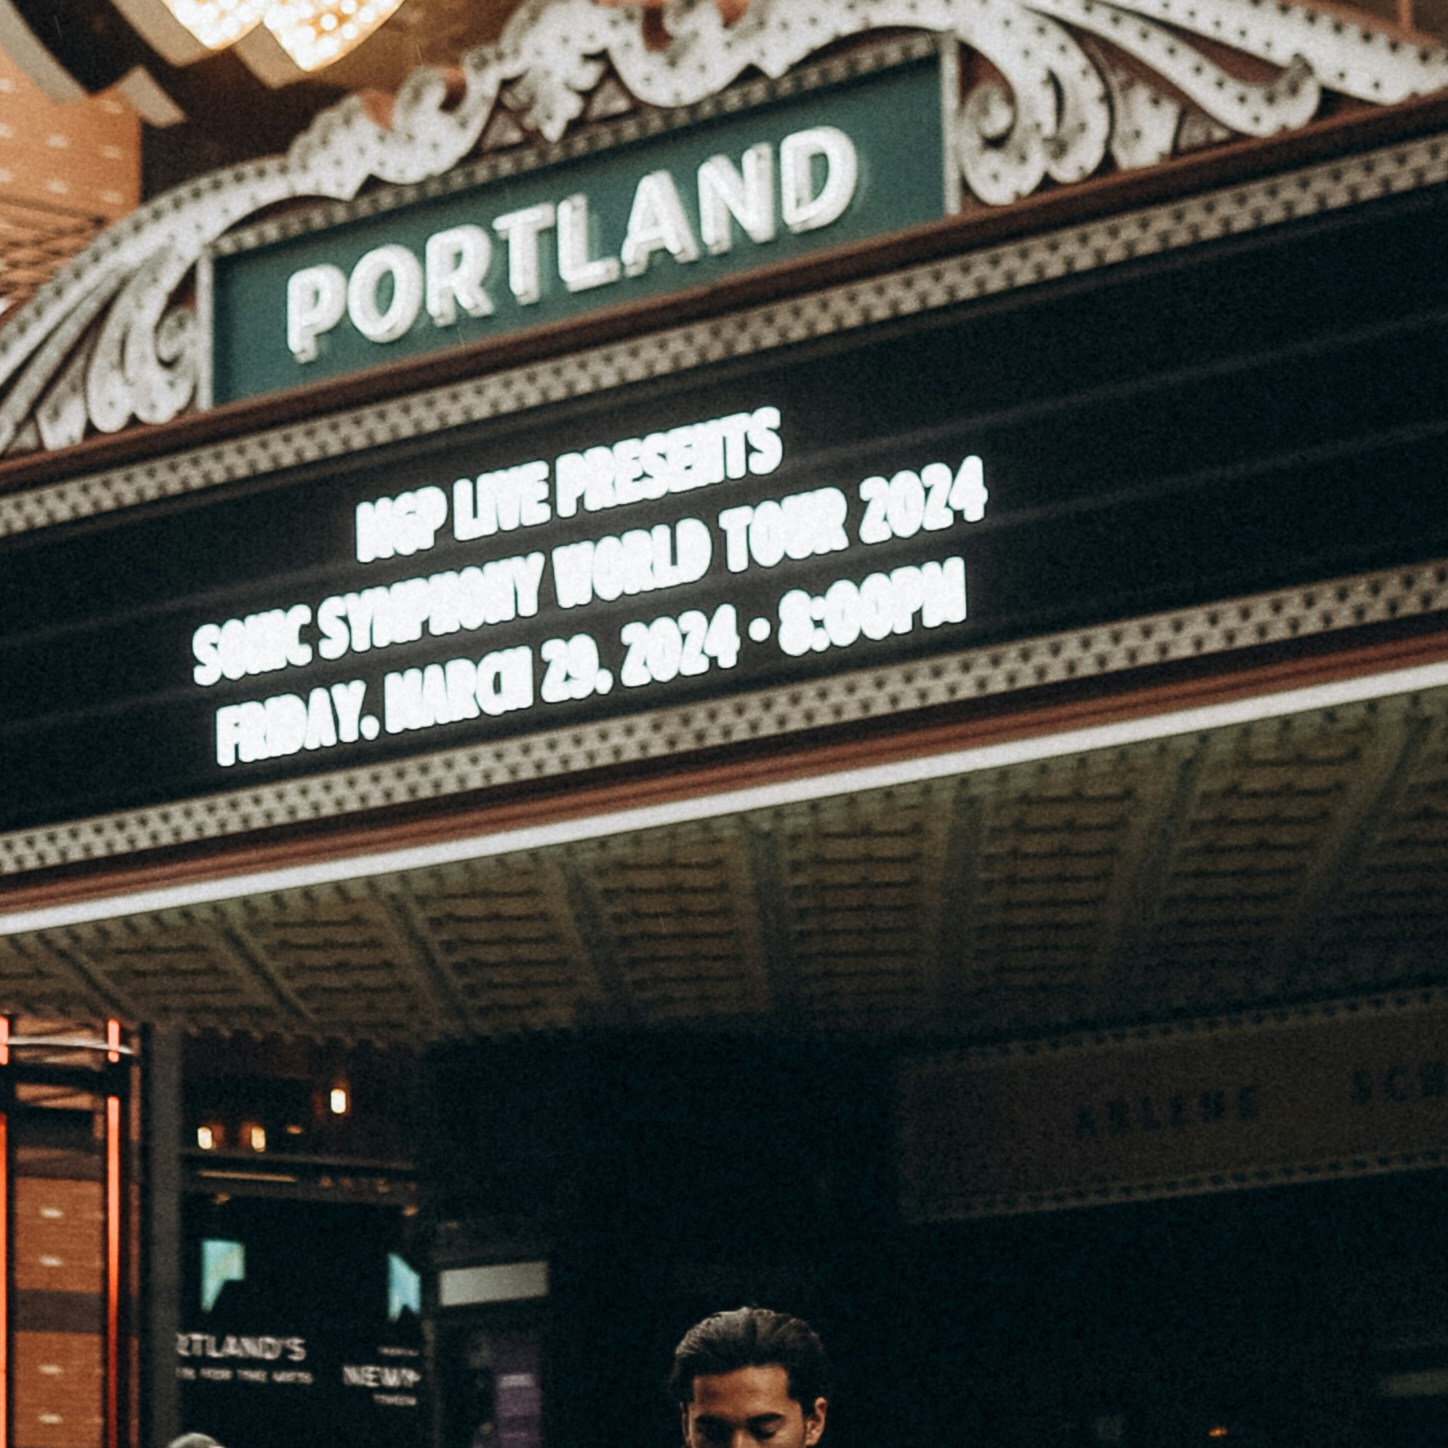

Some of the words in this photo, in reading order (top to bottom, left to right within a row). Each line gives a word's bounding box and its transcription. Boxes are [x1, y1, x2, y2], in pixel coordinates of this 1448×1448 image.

[286, 124, 860, 364] PORTLAND
[453, 460, 552, 541] LIVE
[555, 406, 783, 518] PRESENTS
[192, 604, 313, 686] SONIC
[317, 551, 546, 660] SYMPHONY
[551, 517, 713, 609] WORLD
[718, 487, 849, 573] TOUR
[858, 455, 989, 545] 2024
[384, 646, 534, 733] MARCH
[620, 603, 741, 686] 2024
[778, 557, 967, 656] 8:00PM
[1073, 1082, 1259, 1141] ARLENE
